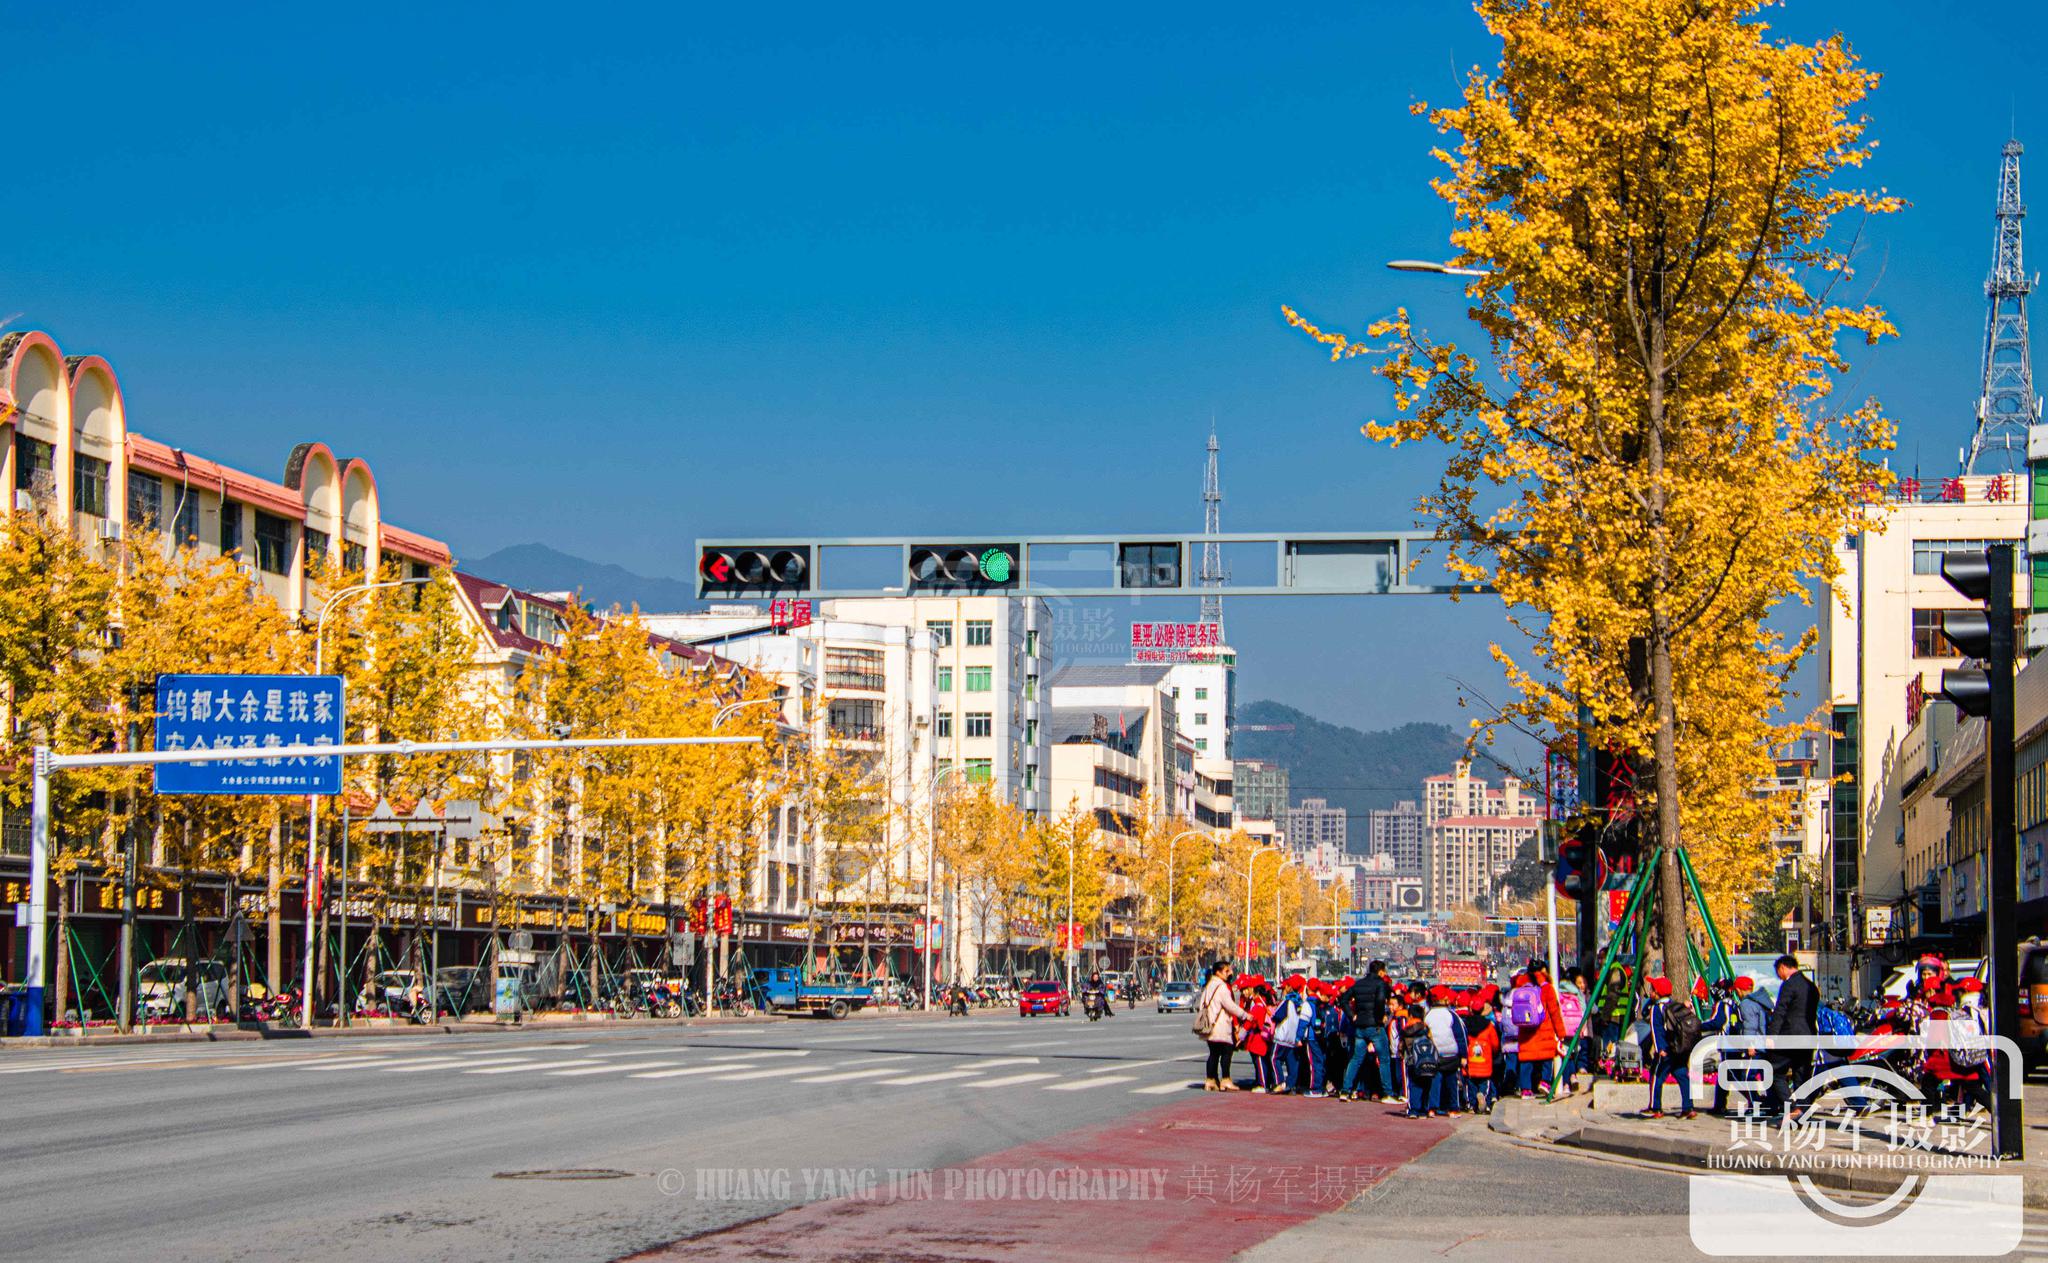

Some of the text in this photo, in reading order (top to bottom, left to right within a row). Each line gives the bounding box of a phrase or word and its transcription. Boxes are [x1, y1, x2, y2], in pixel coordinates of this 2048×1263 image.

[768, 599, 811, 628] 住宿
[1132, 623, 1218, 648] 黑恶必除除恶务尽
[166, 689, 333, 723] 钨都大余是我家
